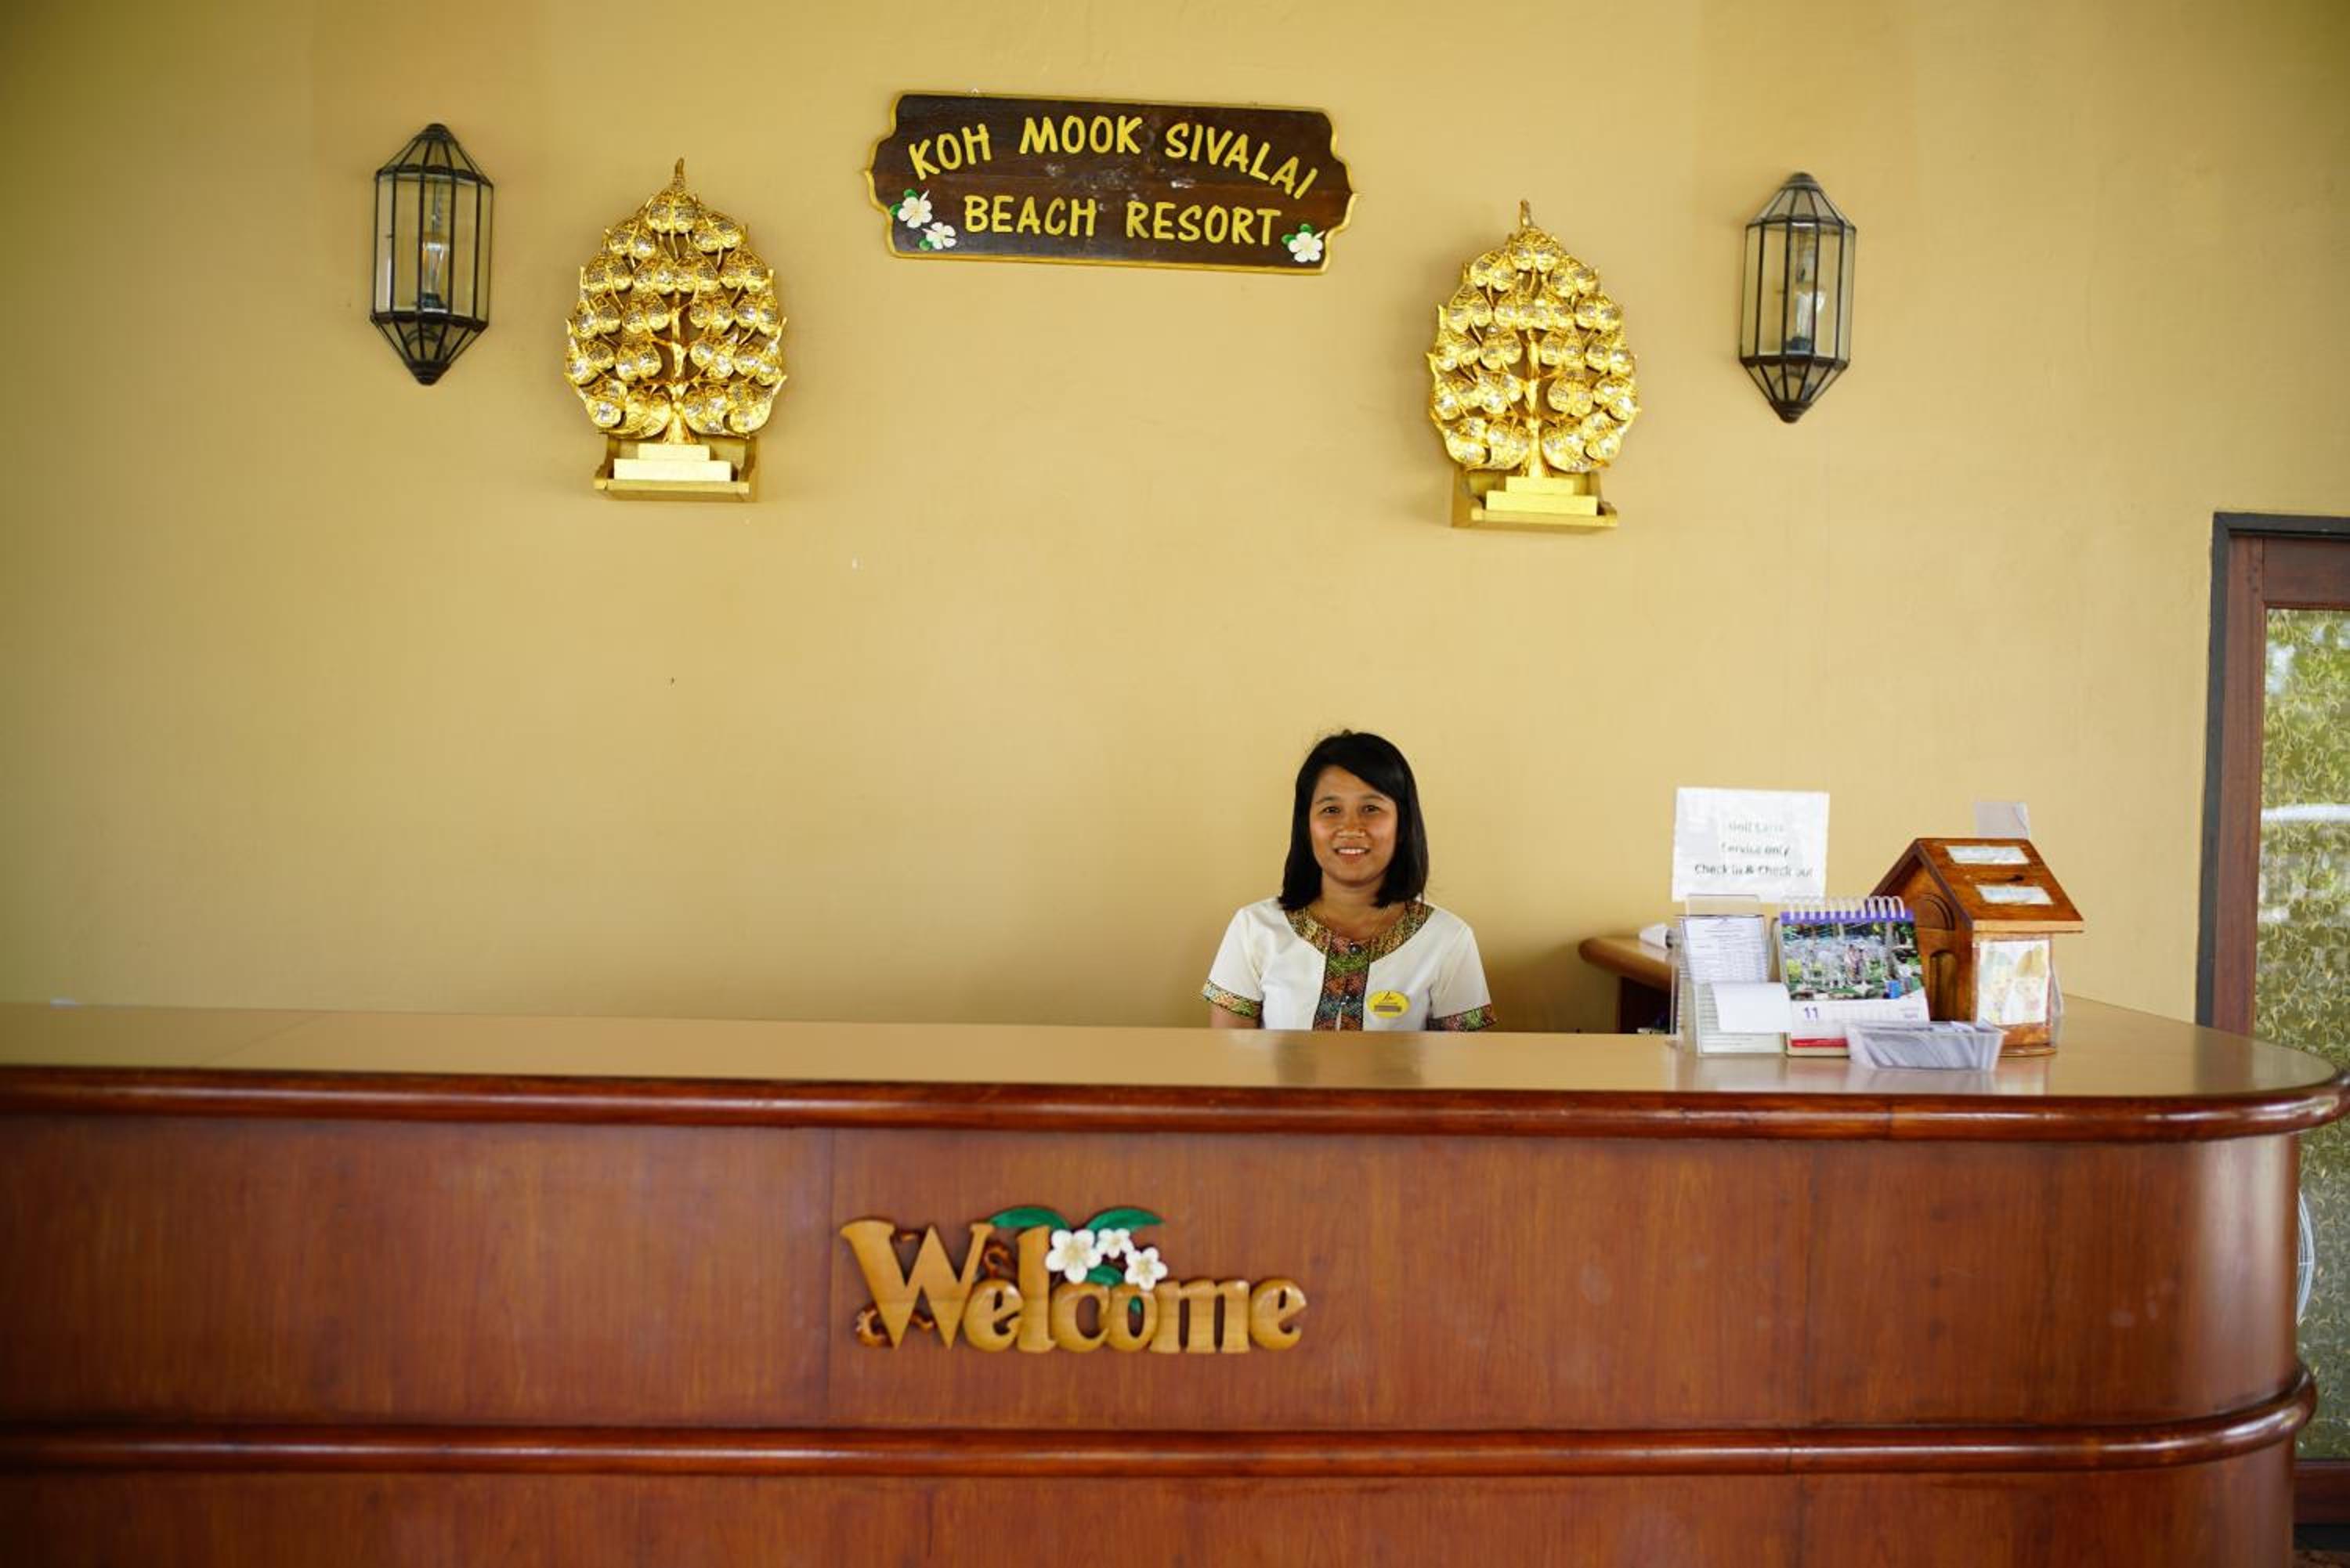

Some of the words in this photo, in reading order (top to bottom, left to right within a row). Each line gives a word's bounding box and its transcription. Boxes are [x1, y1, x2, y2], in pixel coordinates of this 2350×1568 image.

[909, 124, 991, 180] KOH
[1019, 116, 1142, 154] MOOK
[1166, 123, 1318, 199] SIVALAI
[964, 195, 1097, 237] BEACH
[1126, 201, 1282, 246] RESORT
[1694, 864, 1727, 876] Check
[1804, 1006, 1818, 1018] 11
[841, 1219, 1307, 1353] Welcome
